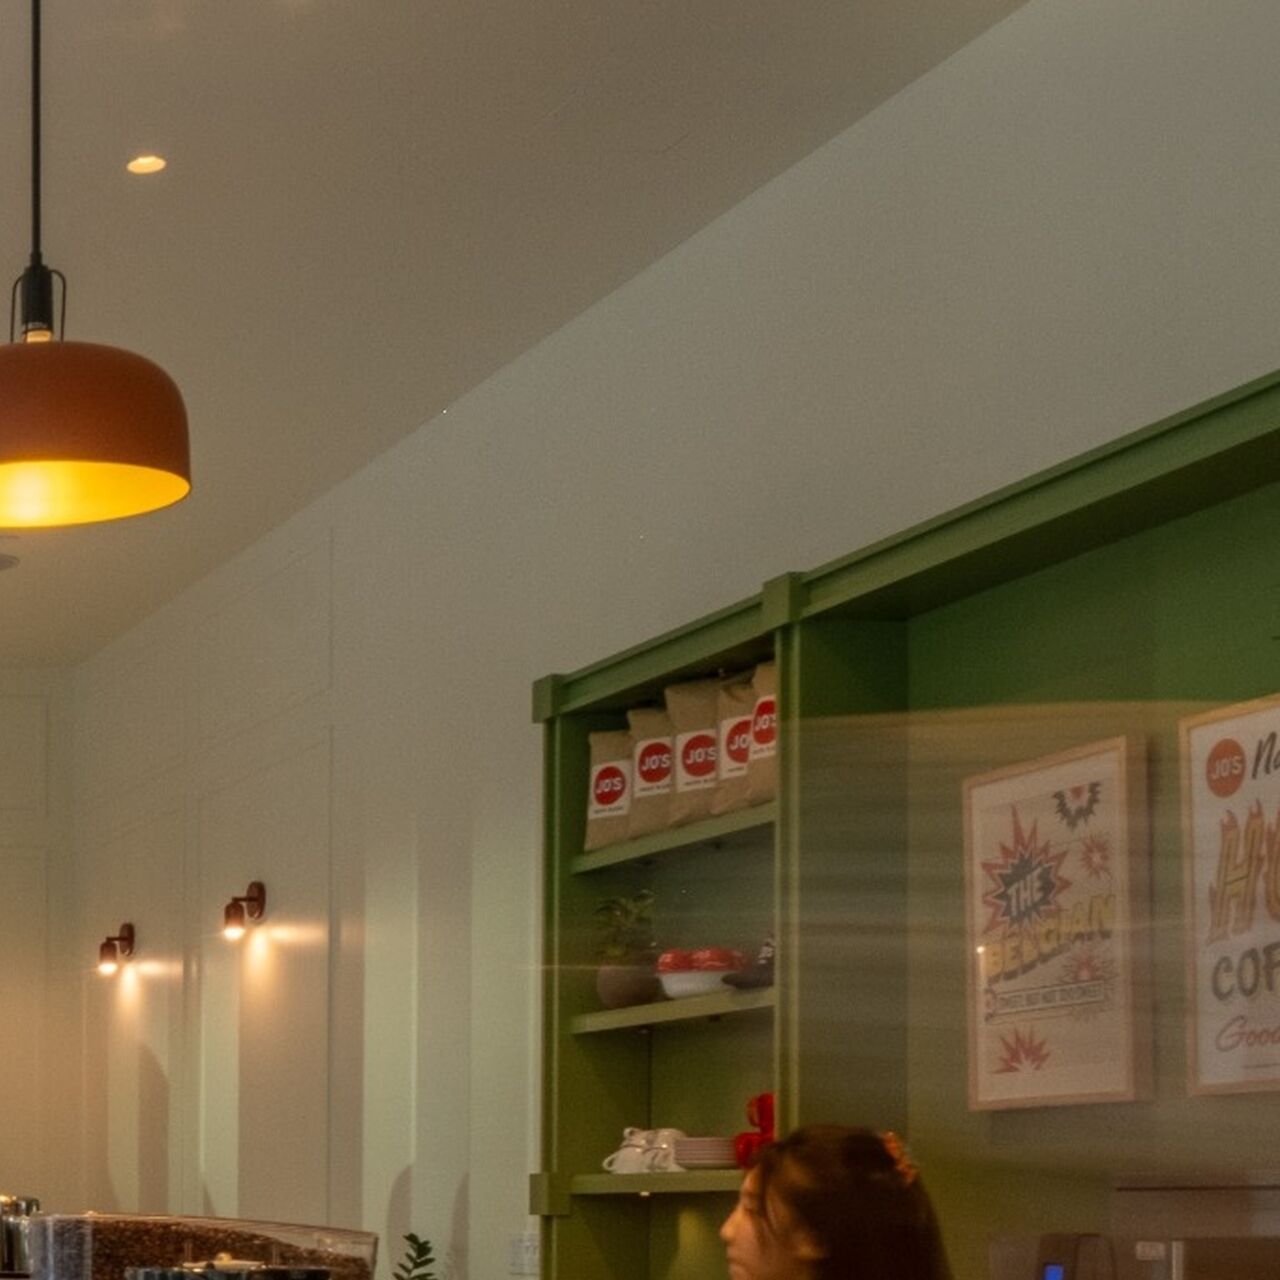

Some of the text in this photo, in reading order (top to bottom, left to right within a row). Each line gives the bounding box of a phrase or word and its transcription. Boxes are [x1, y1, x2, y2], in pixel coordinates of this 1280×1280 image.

[641, 754, 671, 771] JO'S
[686, 747, 717, 764] JO'S
[1211, 755, 1242, 780] JO'S
[595, 777, 623, 793] JO'S
[1007, 868, 1044, 914] THE
